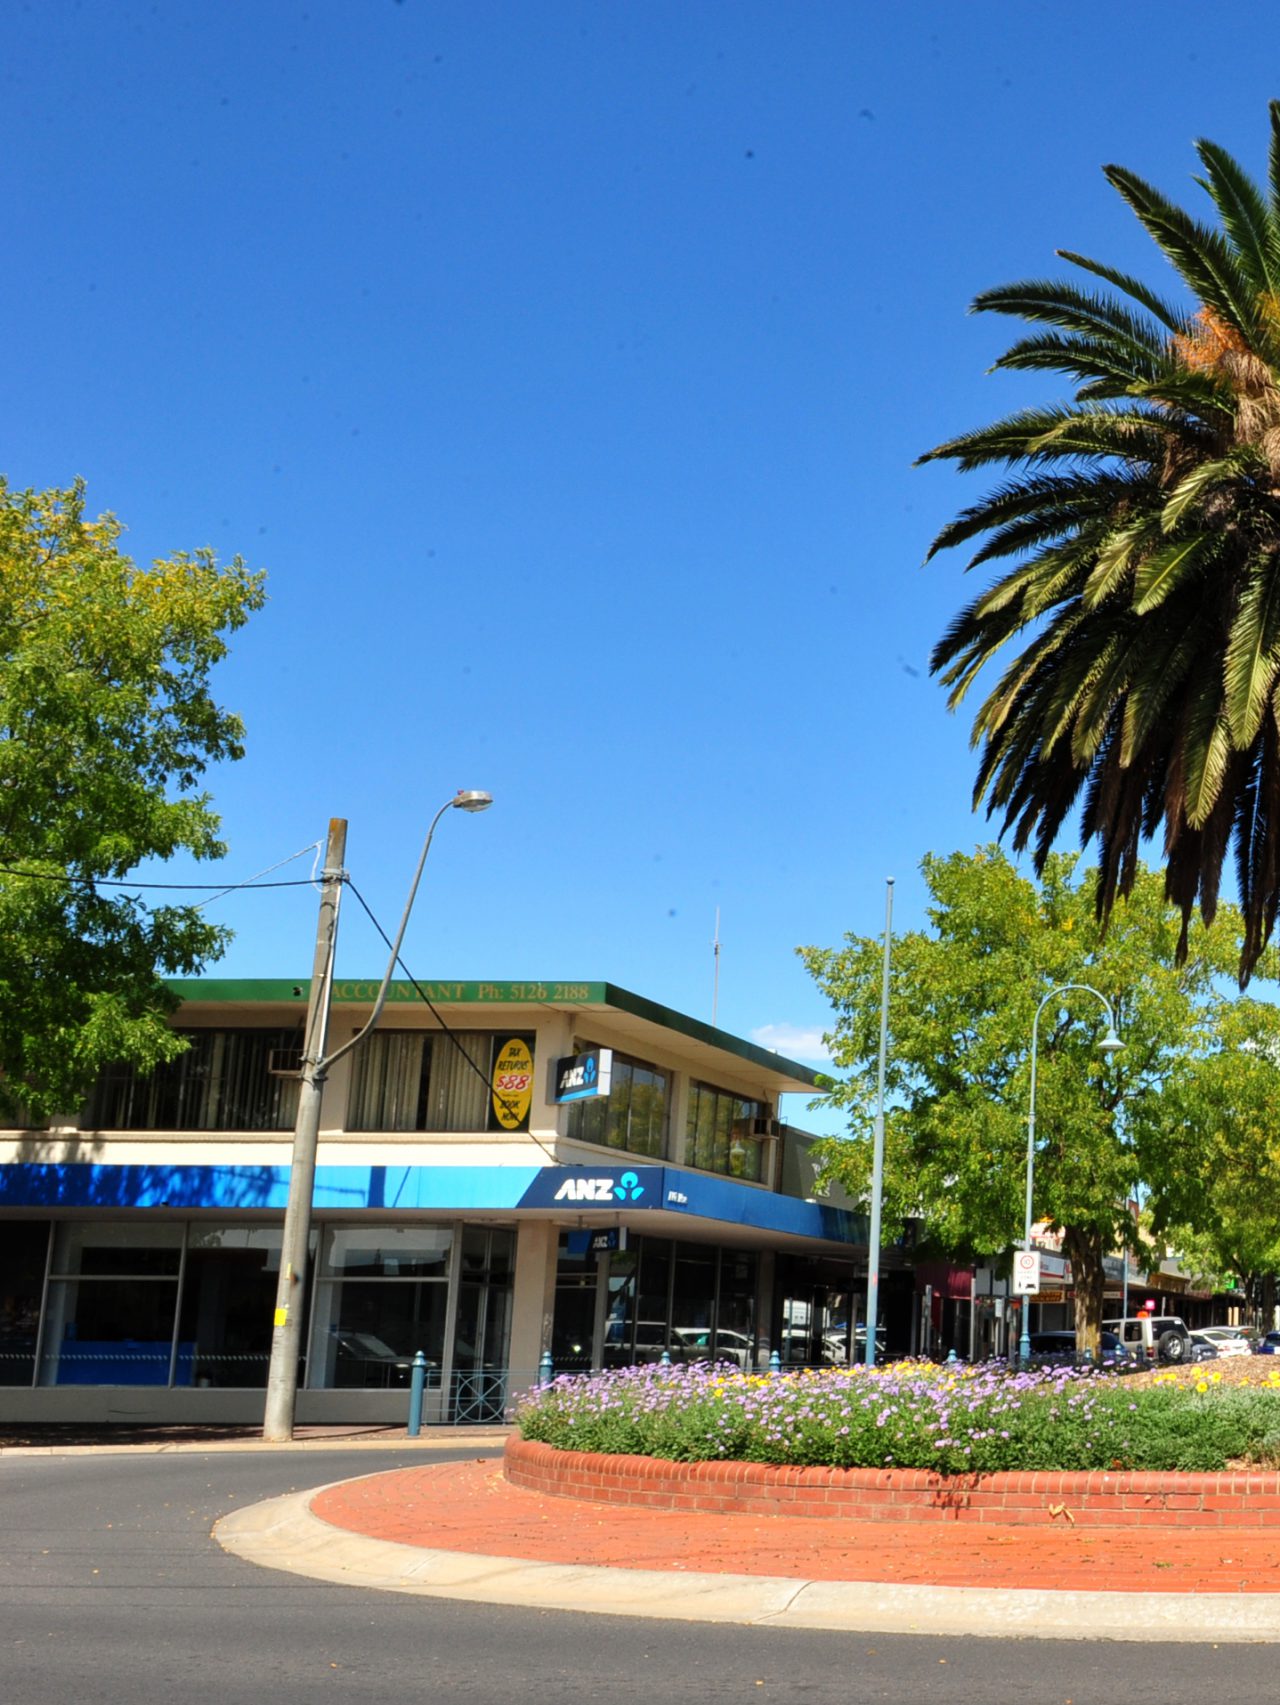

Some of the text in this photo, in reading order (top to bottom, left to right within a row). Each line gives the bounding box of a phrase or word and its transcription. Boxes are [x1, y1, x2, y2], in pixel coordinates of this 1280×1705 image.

[478, 983, 501, 999] Ph:
[509, 984, 547, 999] 5126
[553, 984, 589, 999] 2188
[508, 1047, 522, 1057] TAX
[497, 1060, 530, 1071] RETURNS
[495, 1074, 531, 1091] $88
[559, 1066, 585, 1089] ANZ
[554, 1178, 614, 1201] ANZ
[592, 1235, 609, 1249] ANZ
